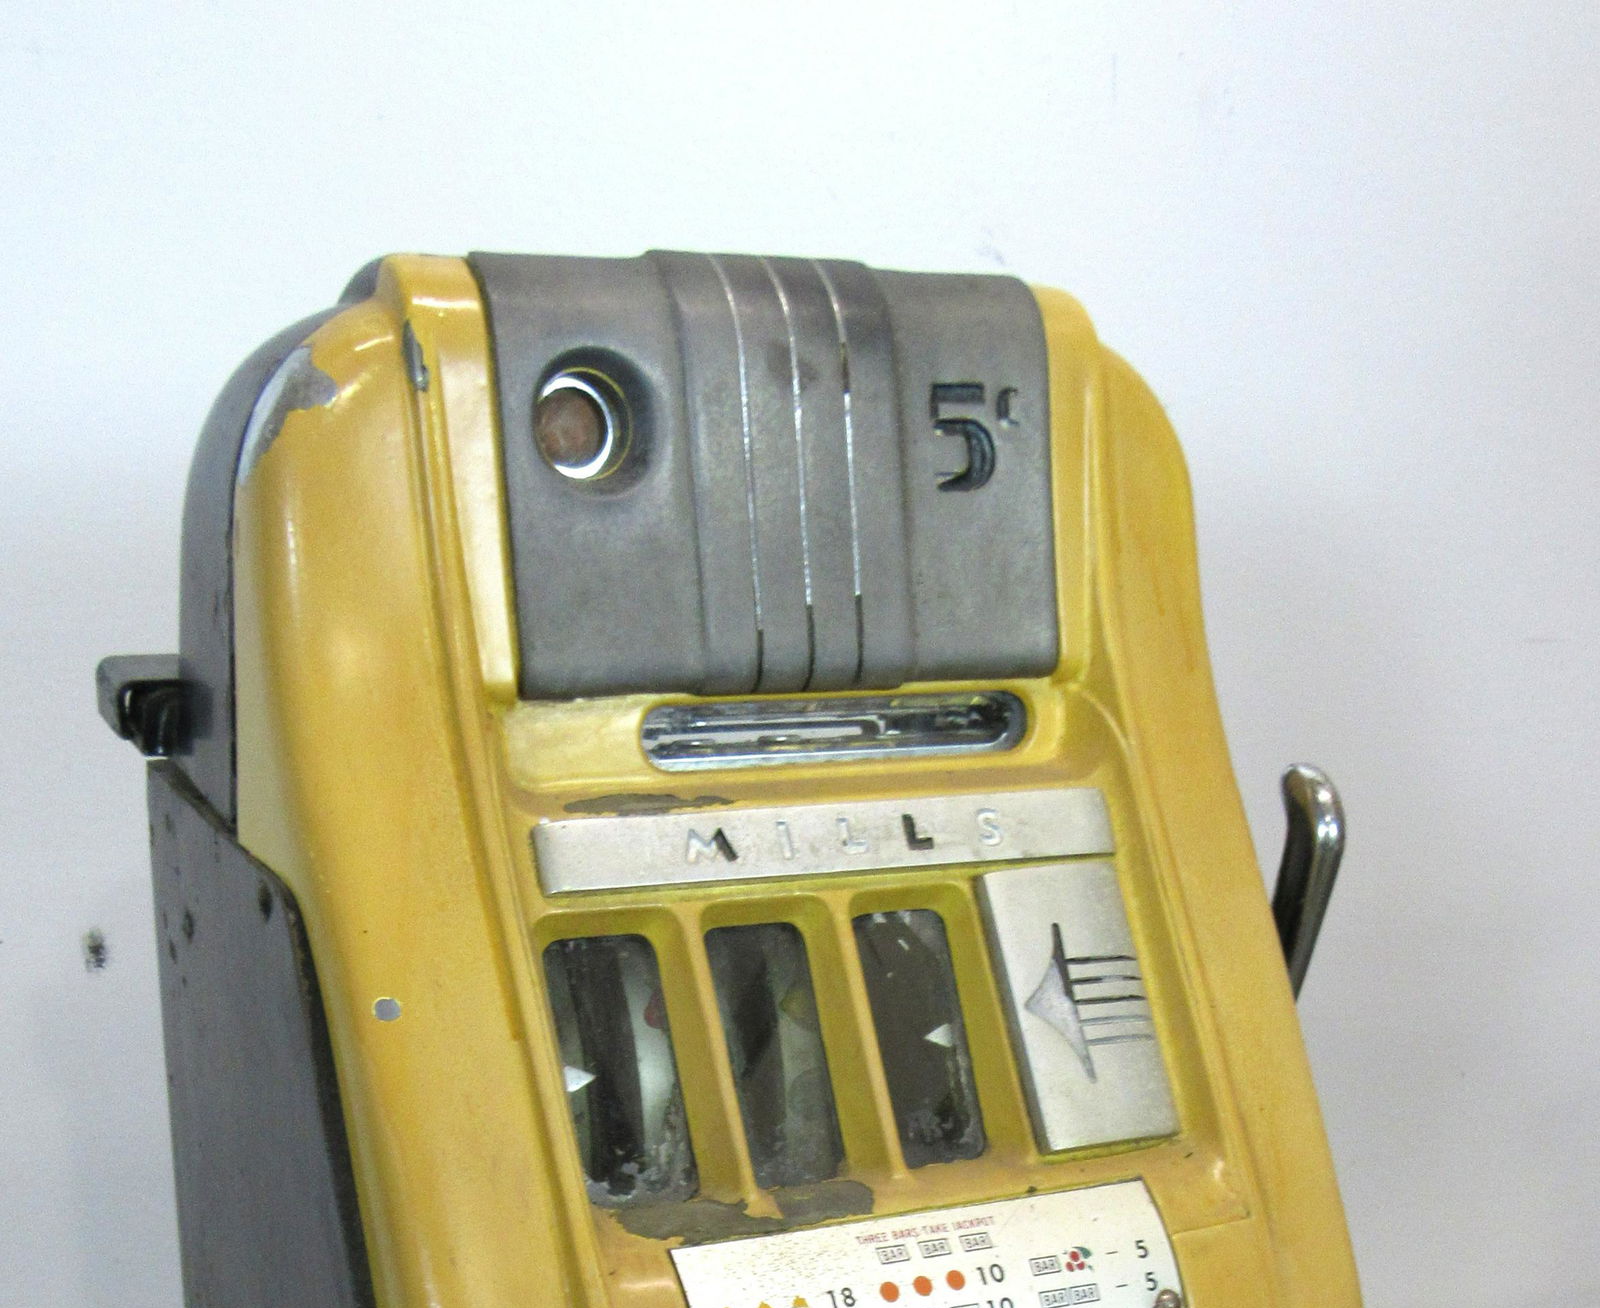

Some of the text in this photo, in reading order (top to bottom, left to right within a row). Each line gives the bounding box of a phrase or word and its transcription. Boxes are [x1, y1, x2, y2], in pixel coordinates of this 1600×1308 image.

[686, 808, 1004, 862] MILLS
[855, 1215, 995, 1245] THREE BARS TAKE JACKPOT
[879, 1235, 987, 1262] BAR BAR BAR
[1033, 1239, 1149, 1273] BAR 5
[976, 1263, 1005, 1286] 10
[1043, 1271, 1158, 1307] BAR BAR 5
